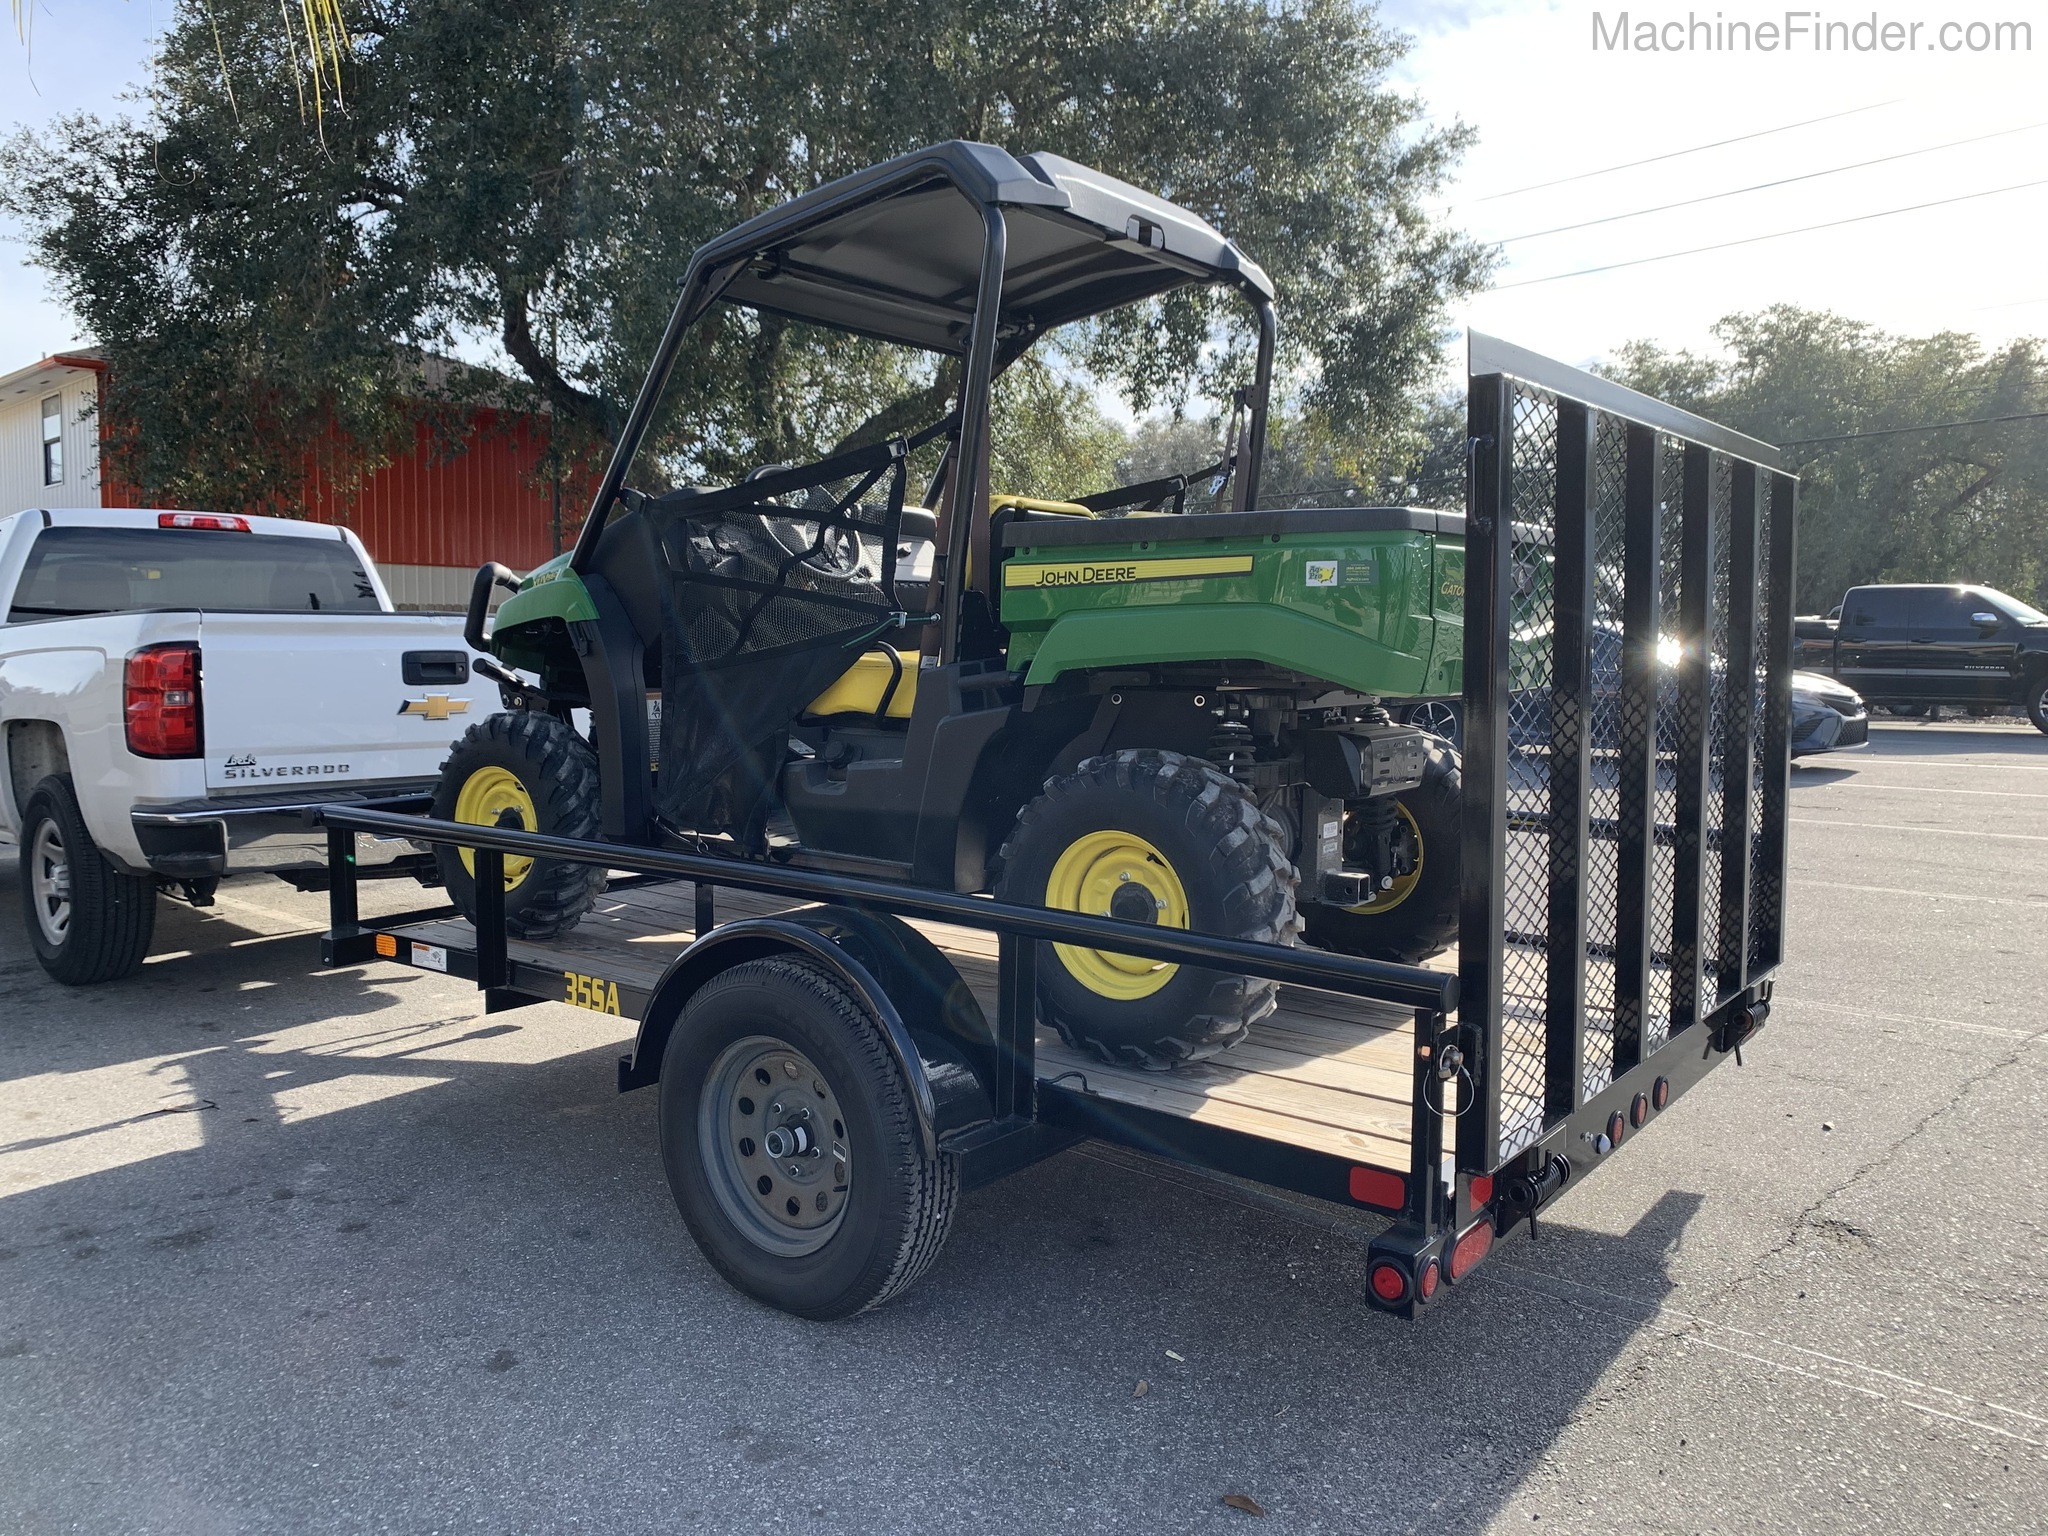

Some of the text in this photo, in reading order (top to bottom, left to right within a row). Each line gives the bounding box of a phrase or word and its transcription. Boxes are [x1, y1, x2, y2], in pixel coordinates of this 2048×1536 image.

[1036, 567, 1136, 585] JOHN DEERE
[224, 764, 350, 779] SILVERADO
[564, 971, 621, 1017] 35SA
